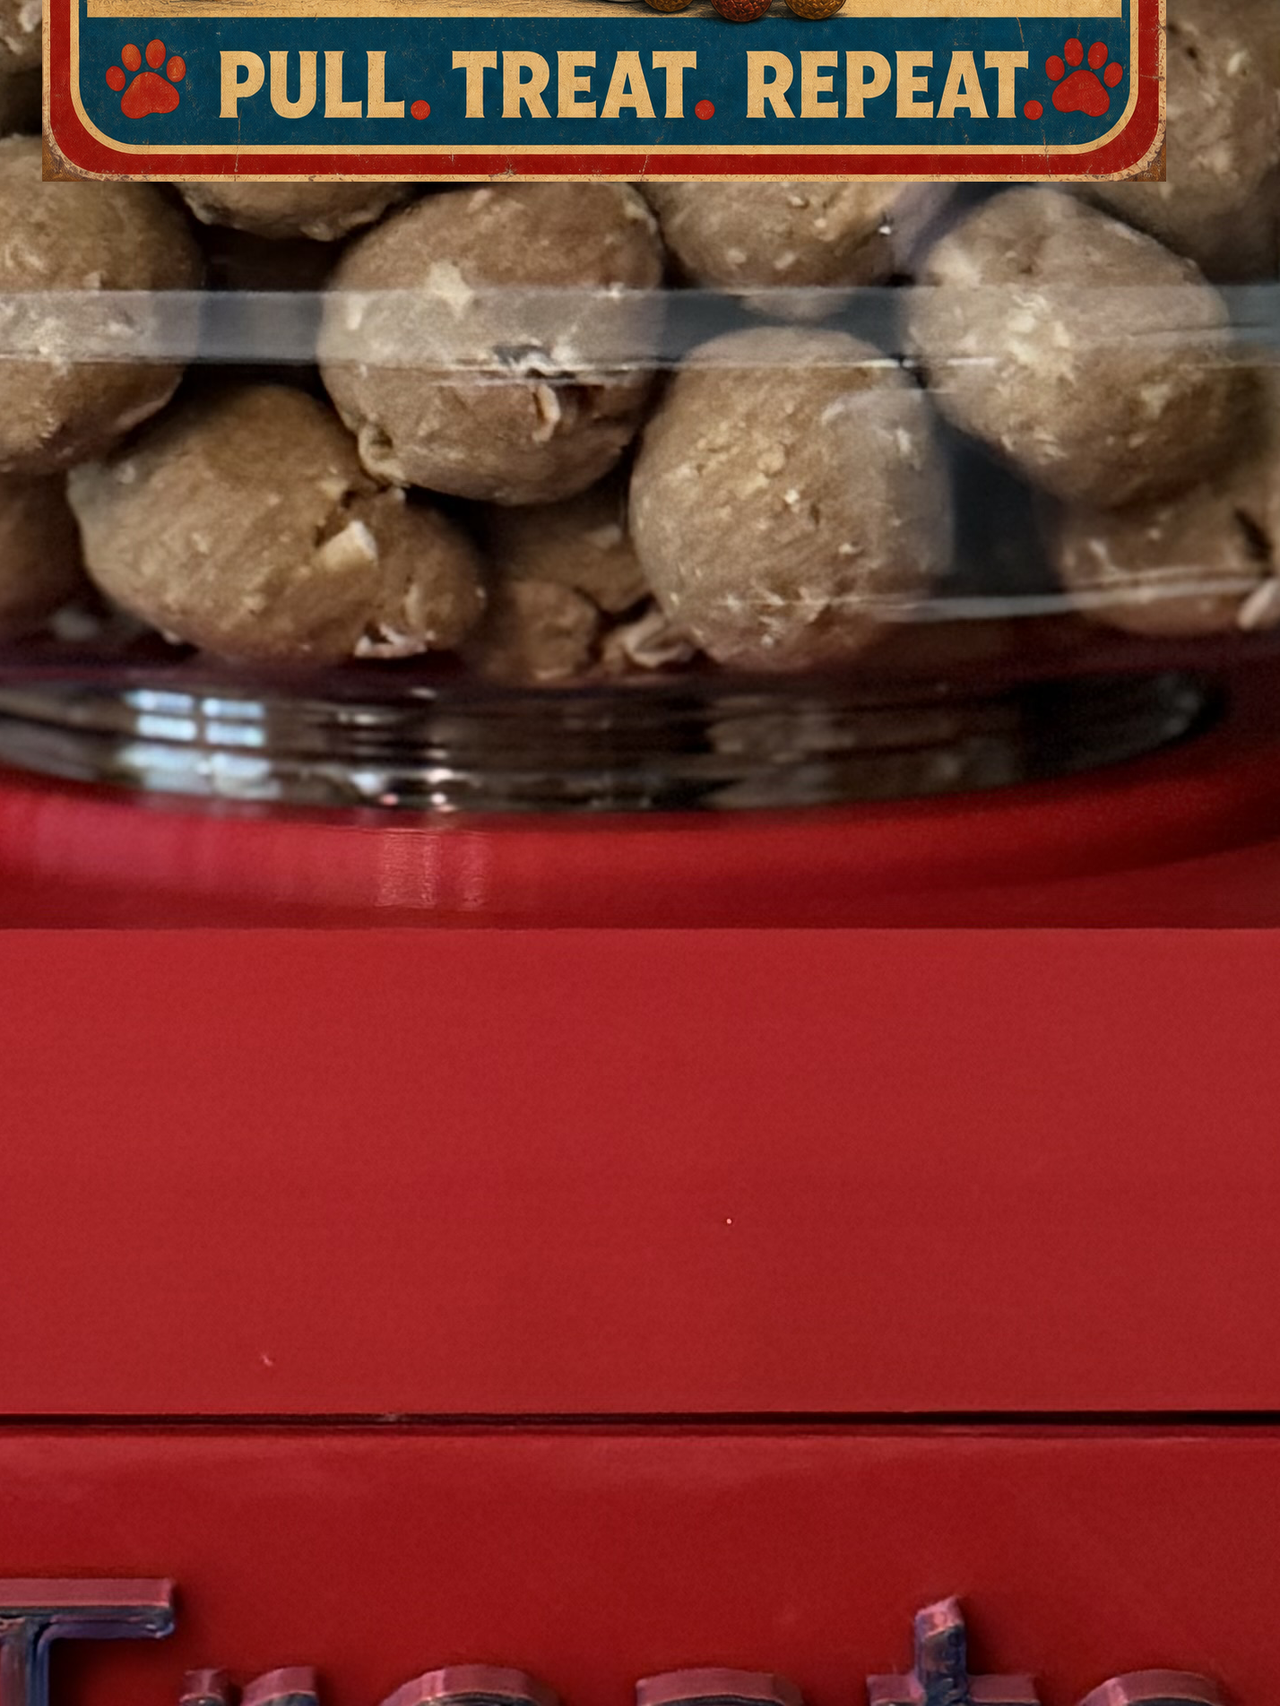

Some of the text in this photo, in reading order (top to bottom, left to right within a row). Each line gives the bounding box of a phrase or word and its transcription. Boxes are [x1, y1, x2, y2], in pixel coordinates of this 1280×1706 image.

[219, 50, 1044, 121] PULL. TREAT. REPEAT.
